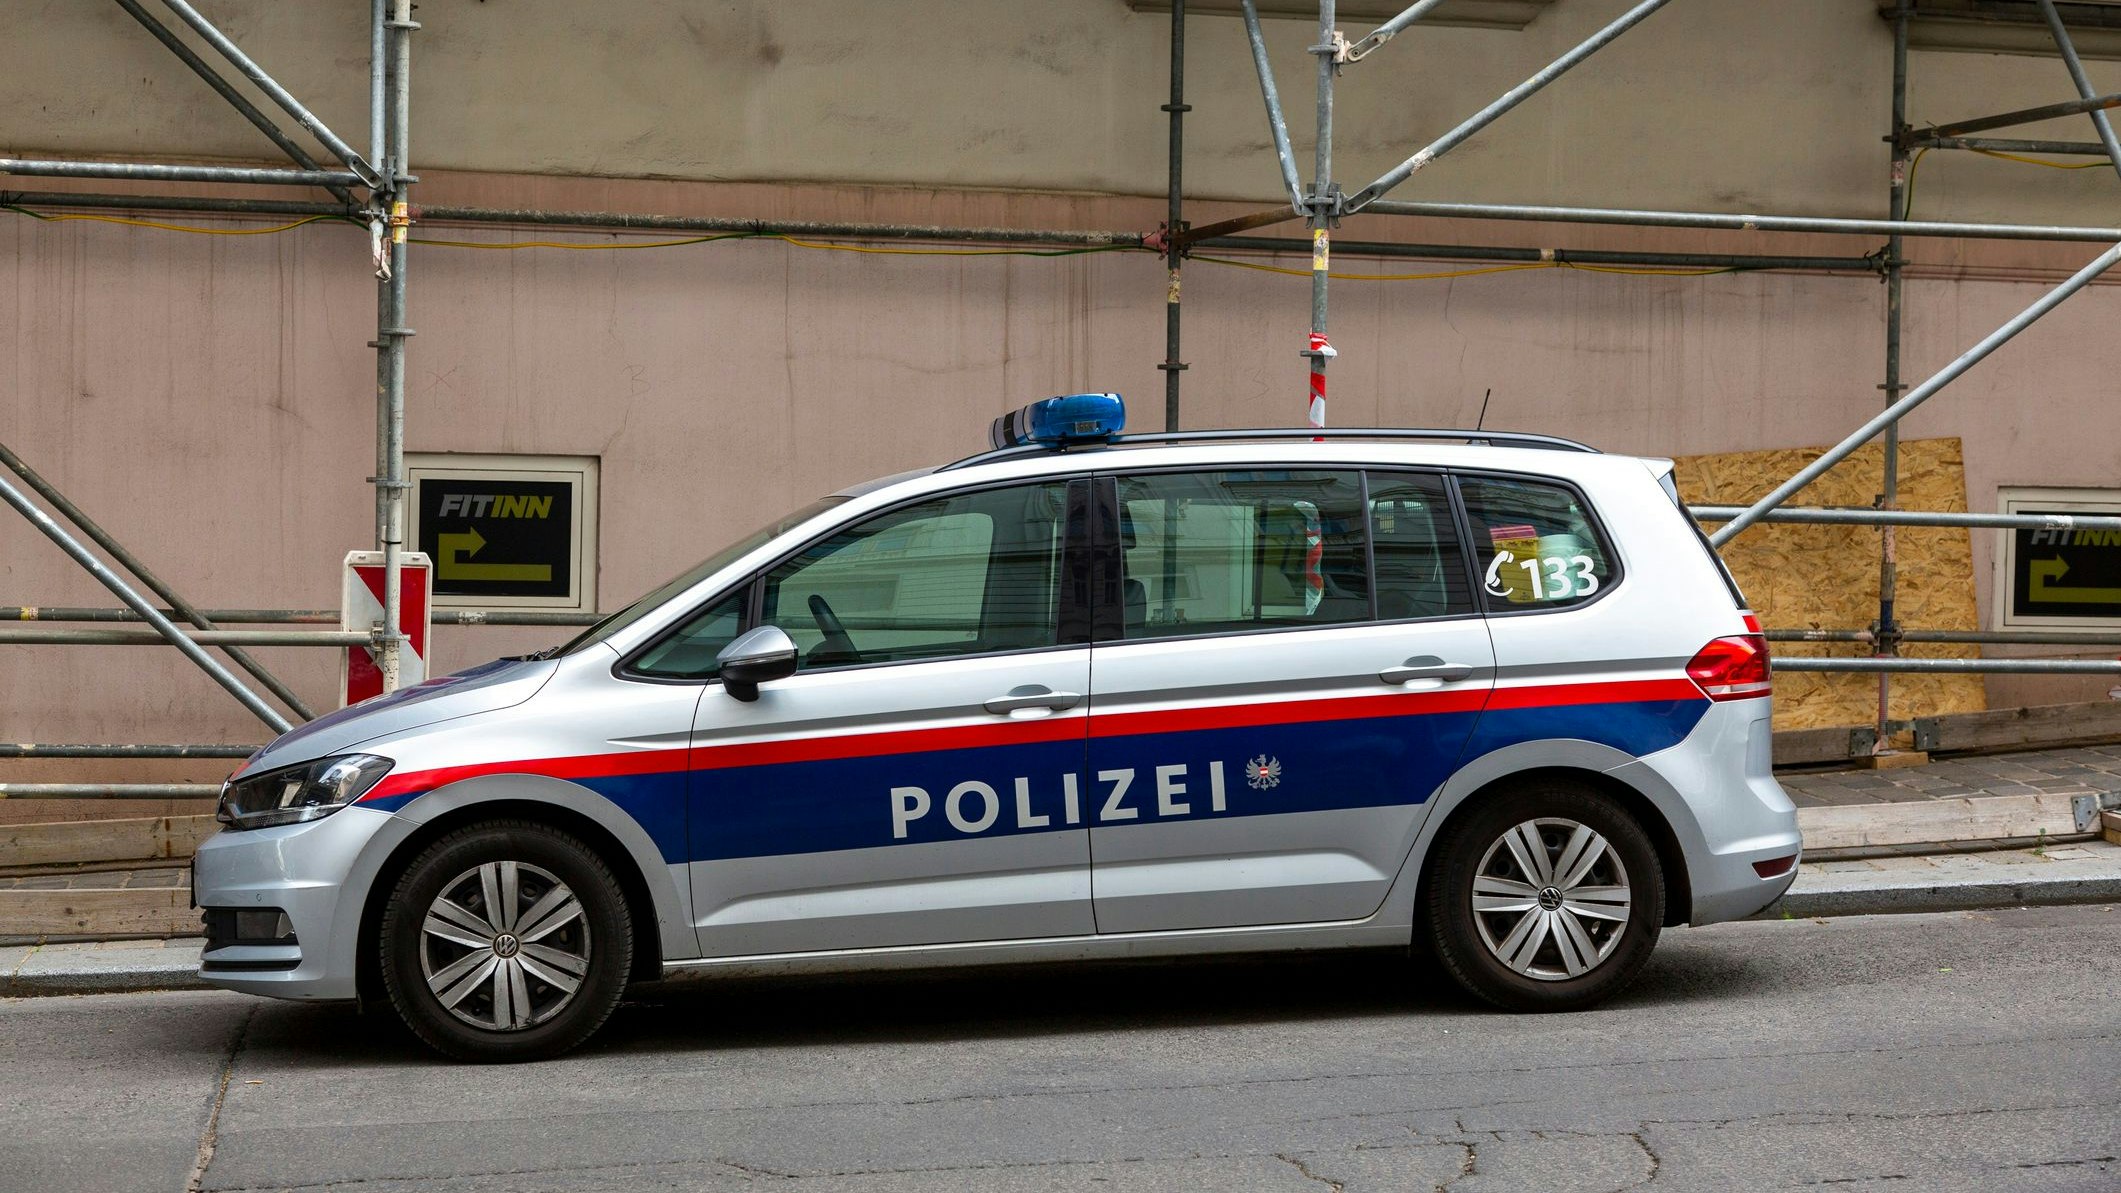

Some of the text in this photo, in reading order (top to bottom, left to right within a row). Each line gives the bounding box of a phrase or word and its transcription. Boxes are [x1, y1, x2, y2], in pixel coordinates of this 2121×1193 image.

[438, 494, 553, 519] FITINN
[1519, 555, 1599, 599] 133
[890, 761, 1226, 838] POLIZEI
